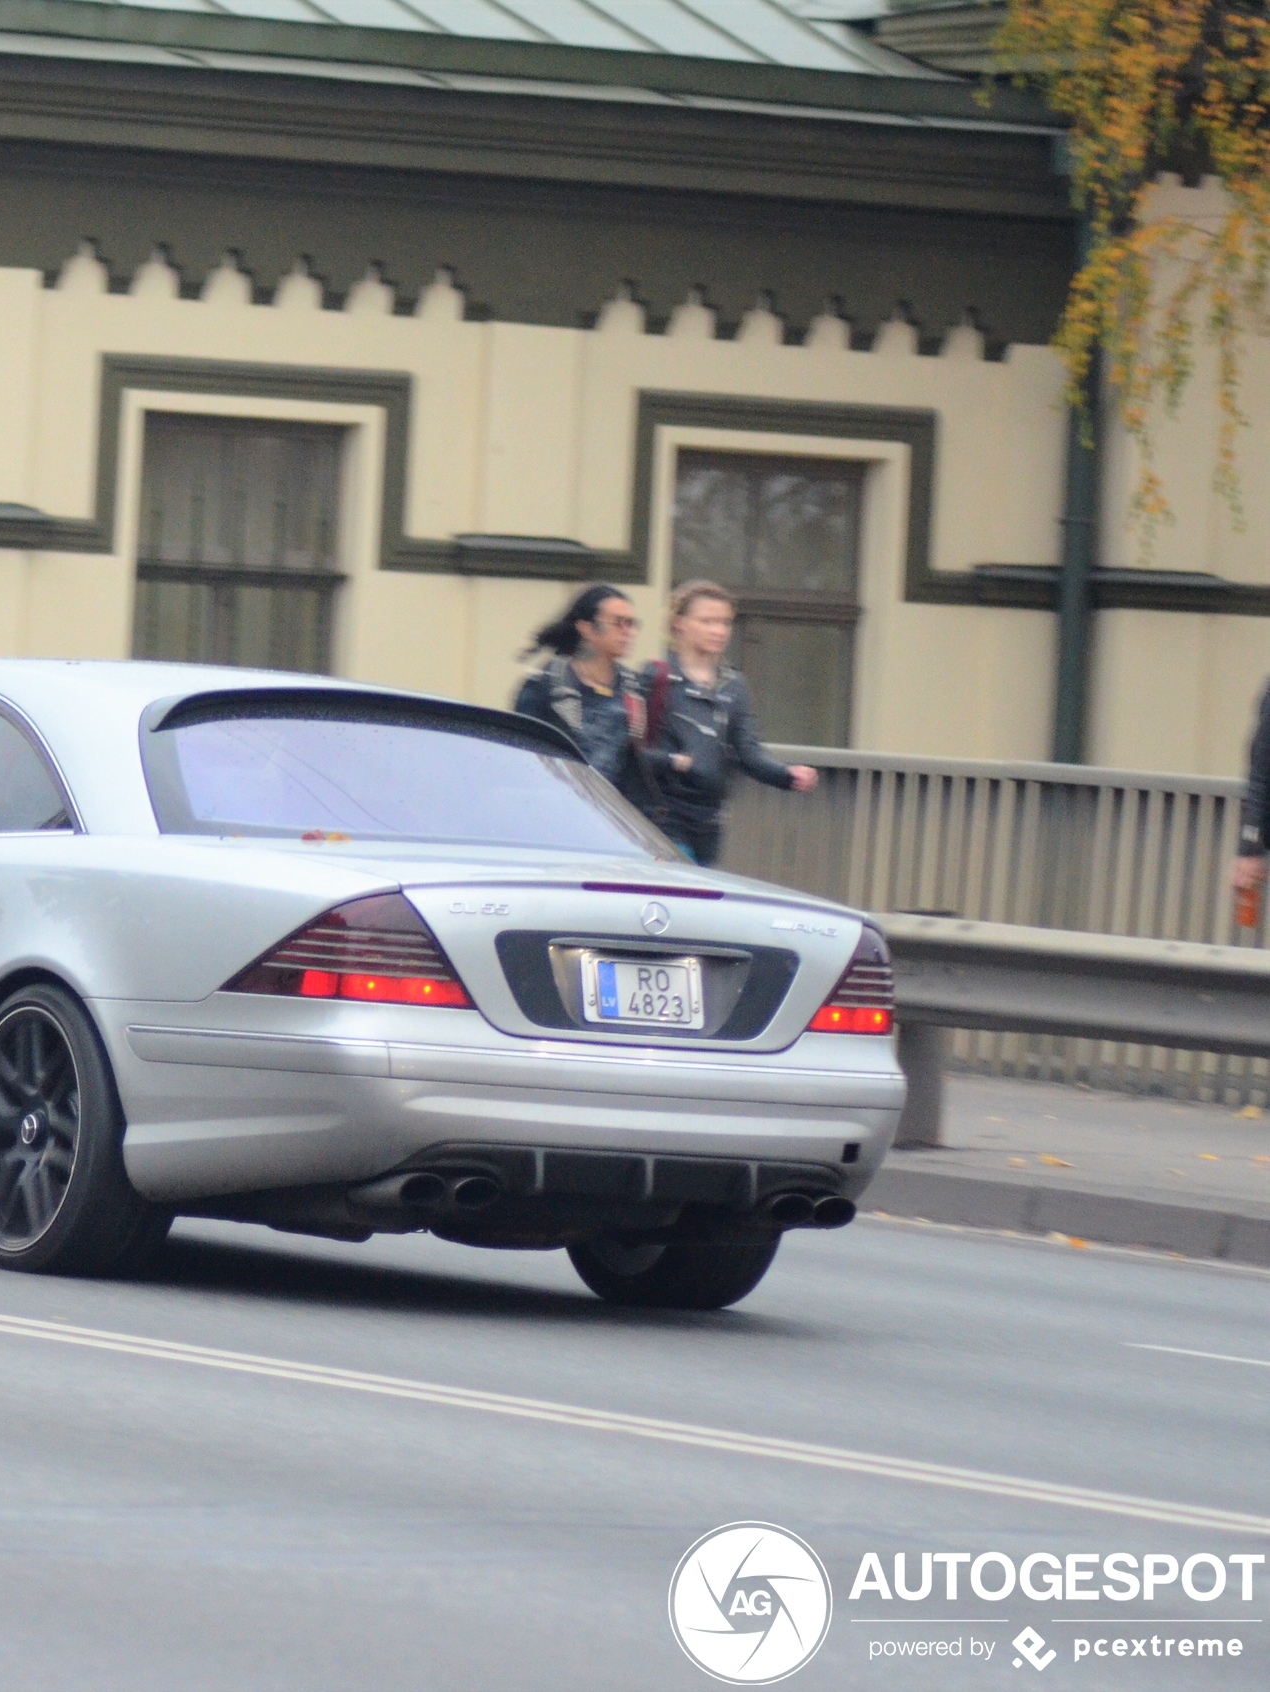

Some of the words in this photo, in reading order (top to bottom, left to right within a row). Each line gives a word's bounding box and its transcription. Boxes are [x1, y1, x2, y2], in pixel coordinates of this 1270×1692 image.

[449, 901, 477, 914] CL
[637, 967, 670, 992] RO
[628, 991, 684, 1018] 4823
